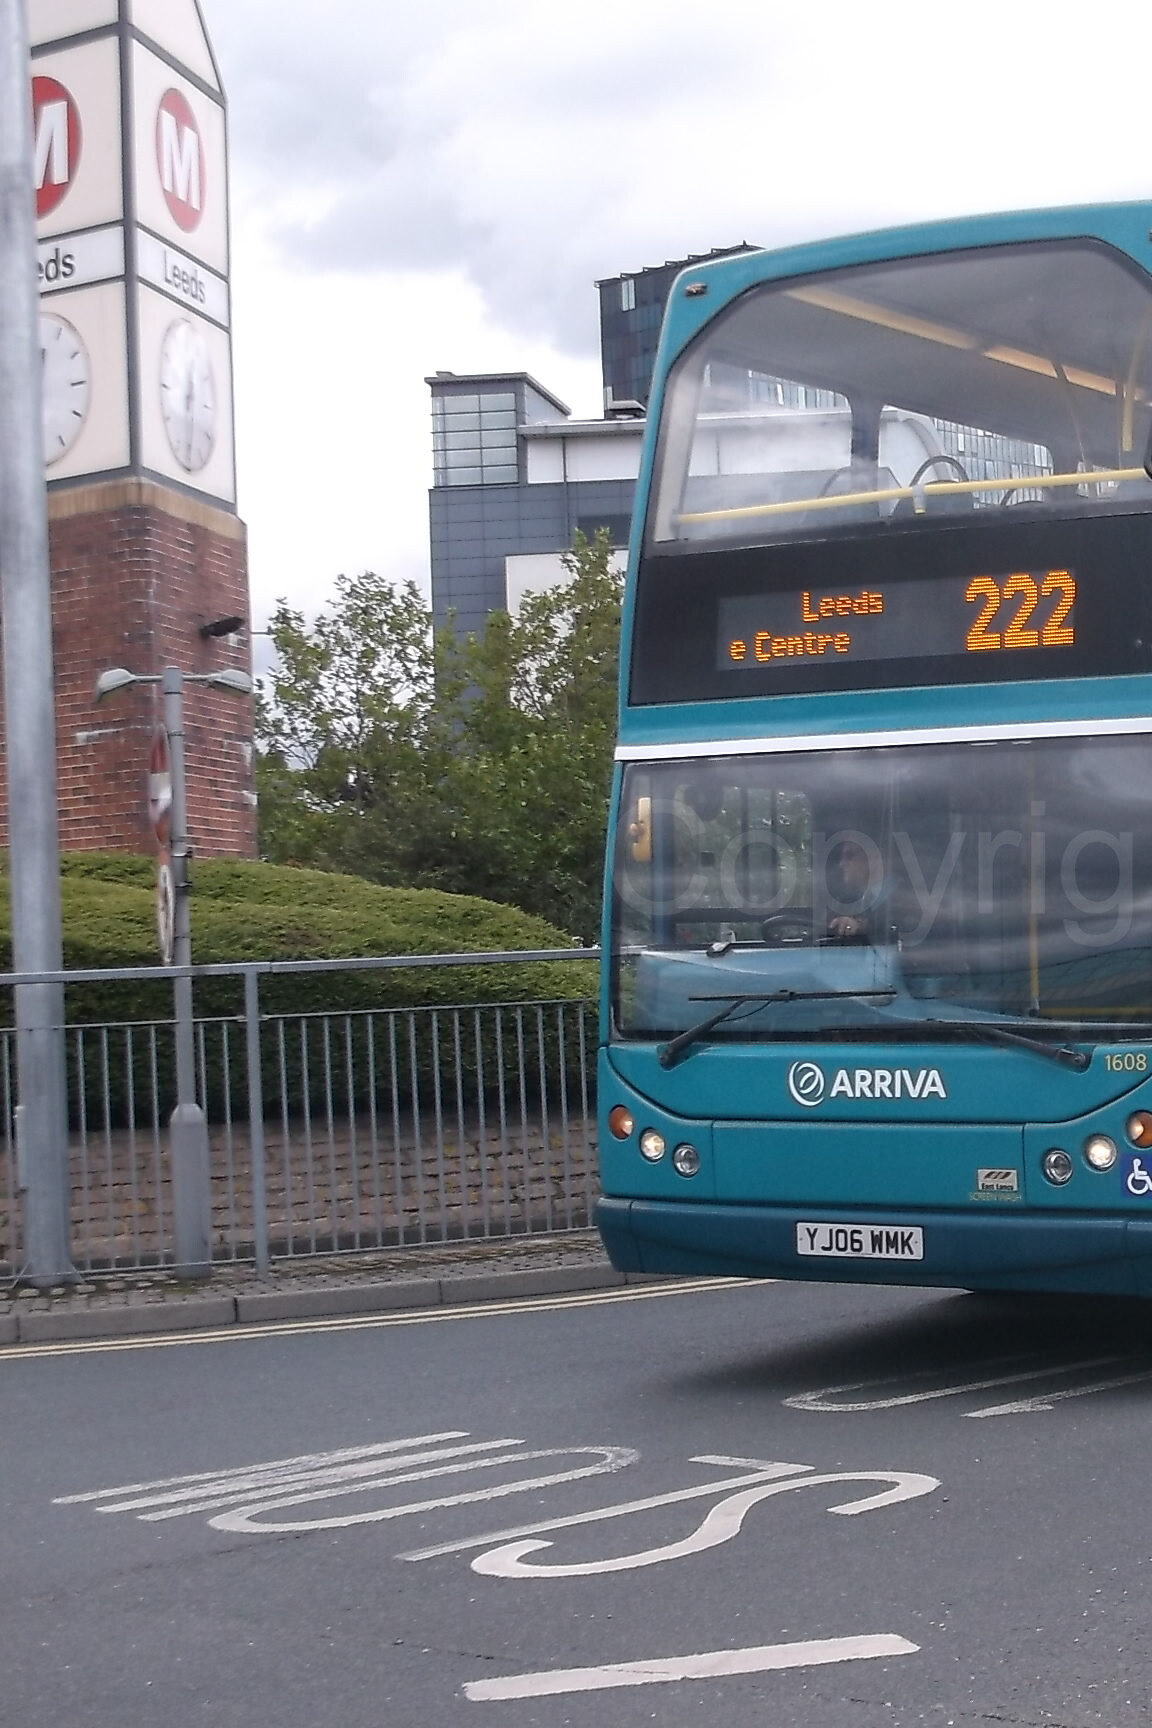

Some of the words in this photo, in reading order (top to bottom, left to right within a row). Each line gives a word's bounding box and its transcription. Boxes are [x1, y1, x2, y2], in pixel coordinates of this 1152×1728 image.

[162, 108, 200, 211] M
[163, 250, 206, 304] Leeds
[803, 591, 884, 623] Leeds
[965, 569, 1077, 651] 222
[729, 640, 746, 661] e
[754, 631, 851, 662] Centre
[1104, 1053, 1147, 1072] 1608
[830, 1069, 947, 1098] ARRIVA
[805, 1228, 863, 1253] YJ06
[870, 1230, 915, 1255] WMK
